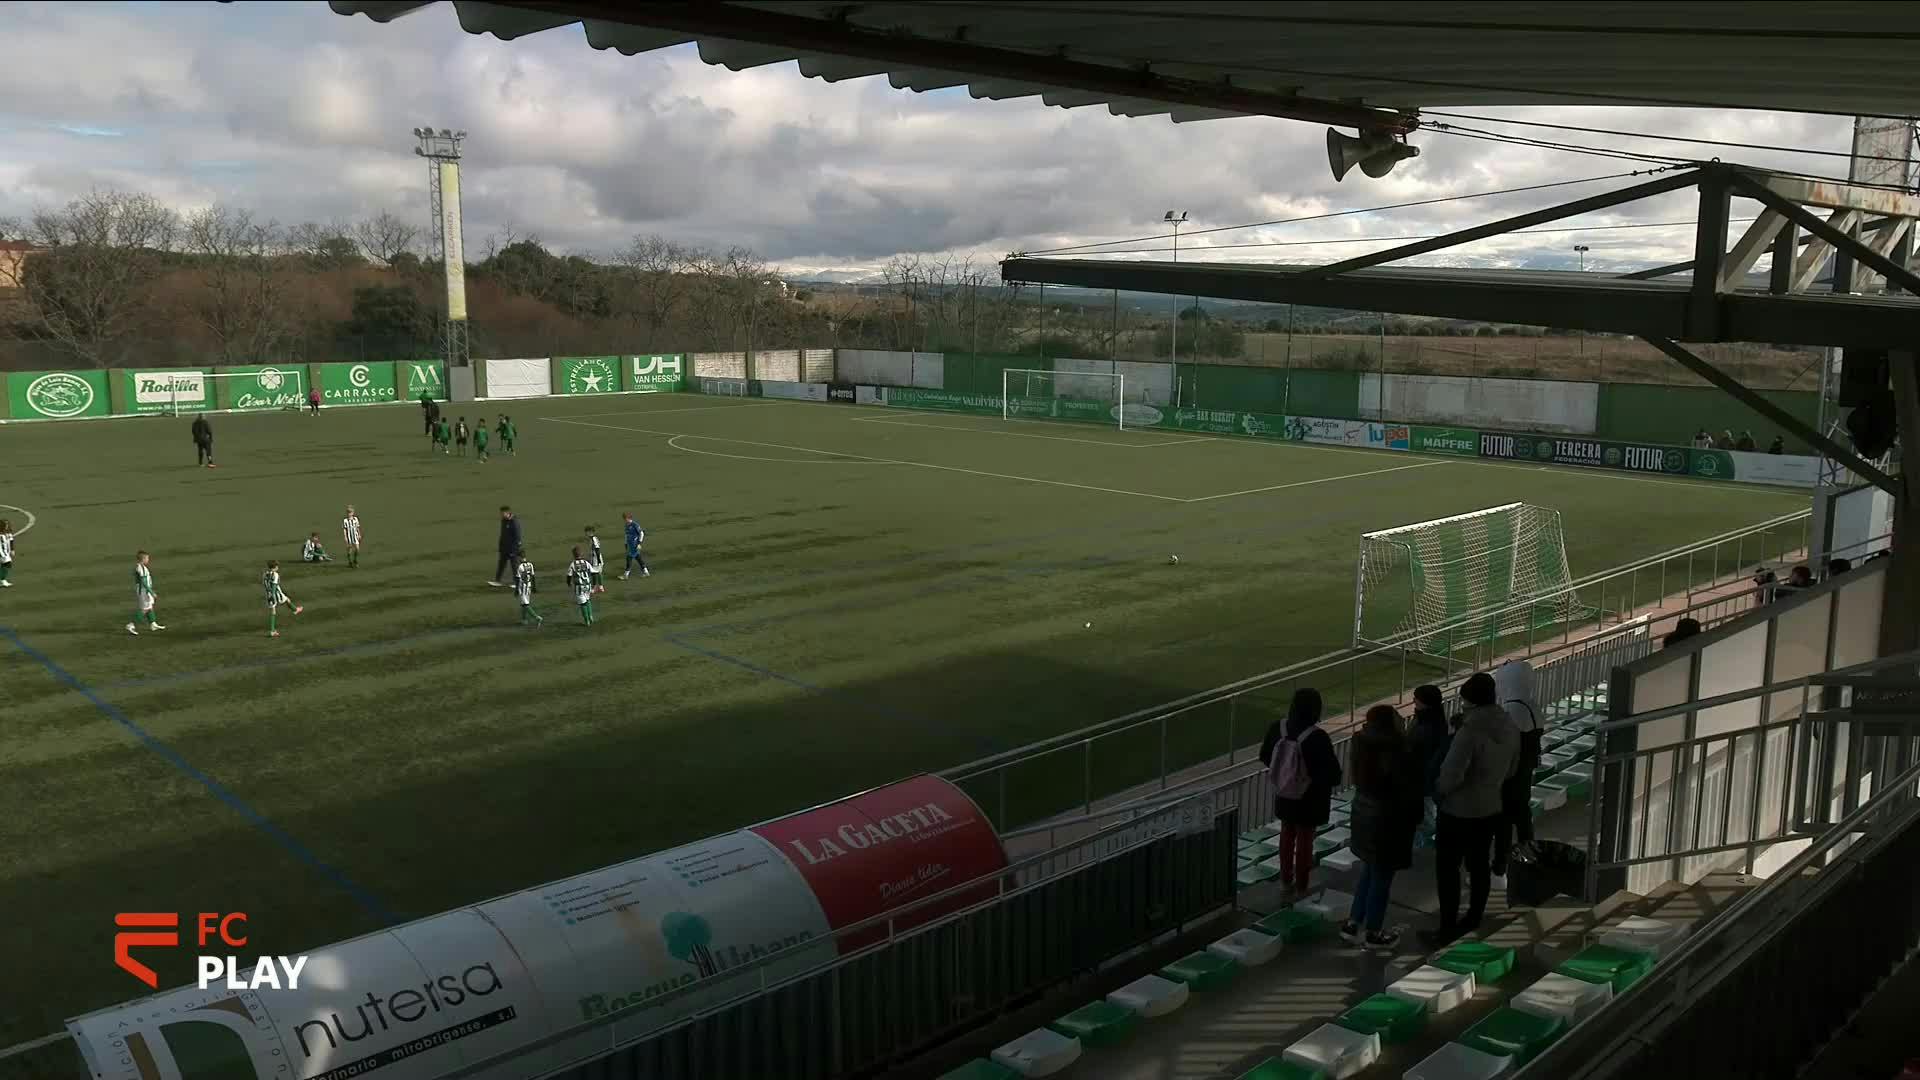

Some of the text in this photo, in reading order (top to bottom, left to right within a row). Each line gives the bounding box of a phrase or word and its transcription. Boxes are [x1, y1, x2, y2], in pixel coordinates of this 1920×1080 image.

[634, 375, 650, 384] VAN
[324, 387, 395, 398] CARRASCO
[1423, 438, 1473, 450] MAPFRE
[1480, 435, 1514, 456] FUTUR
[1555, 441, 1600, 458] TERCERA
[1625, 447, 1664, 470] FUTUR
[837, 803, 952, 849] GACETA
[293, 962, 503, 1057] nutersa
